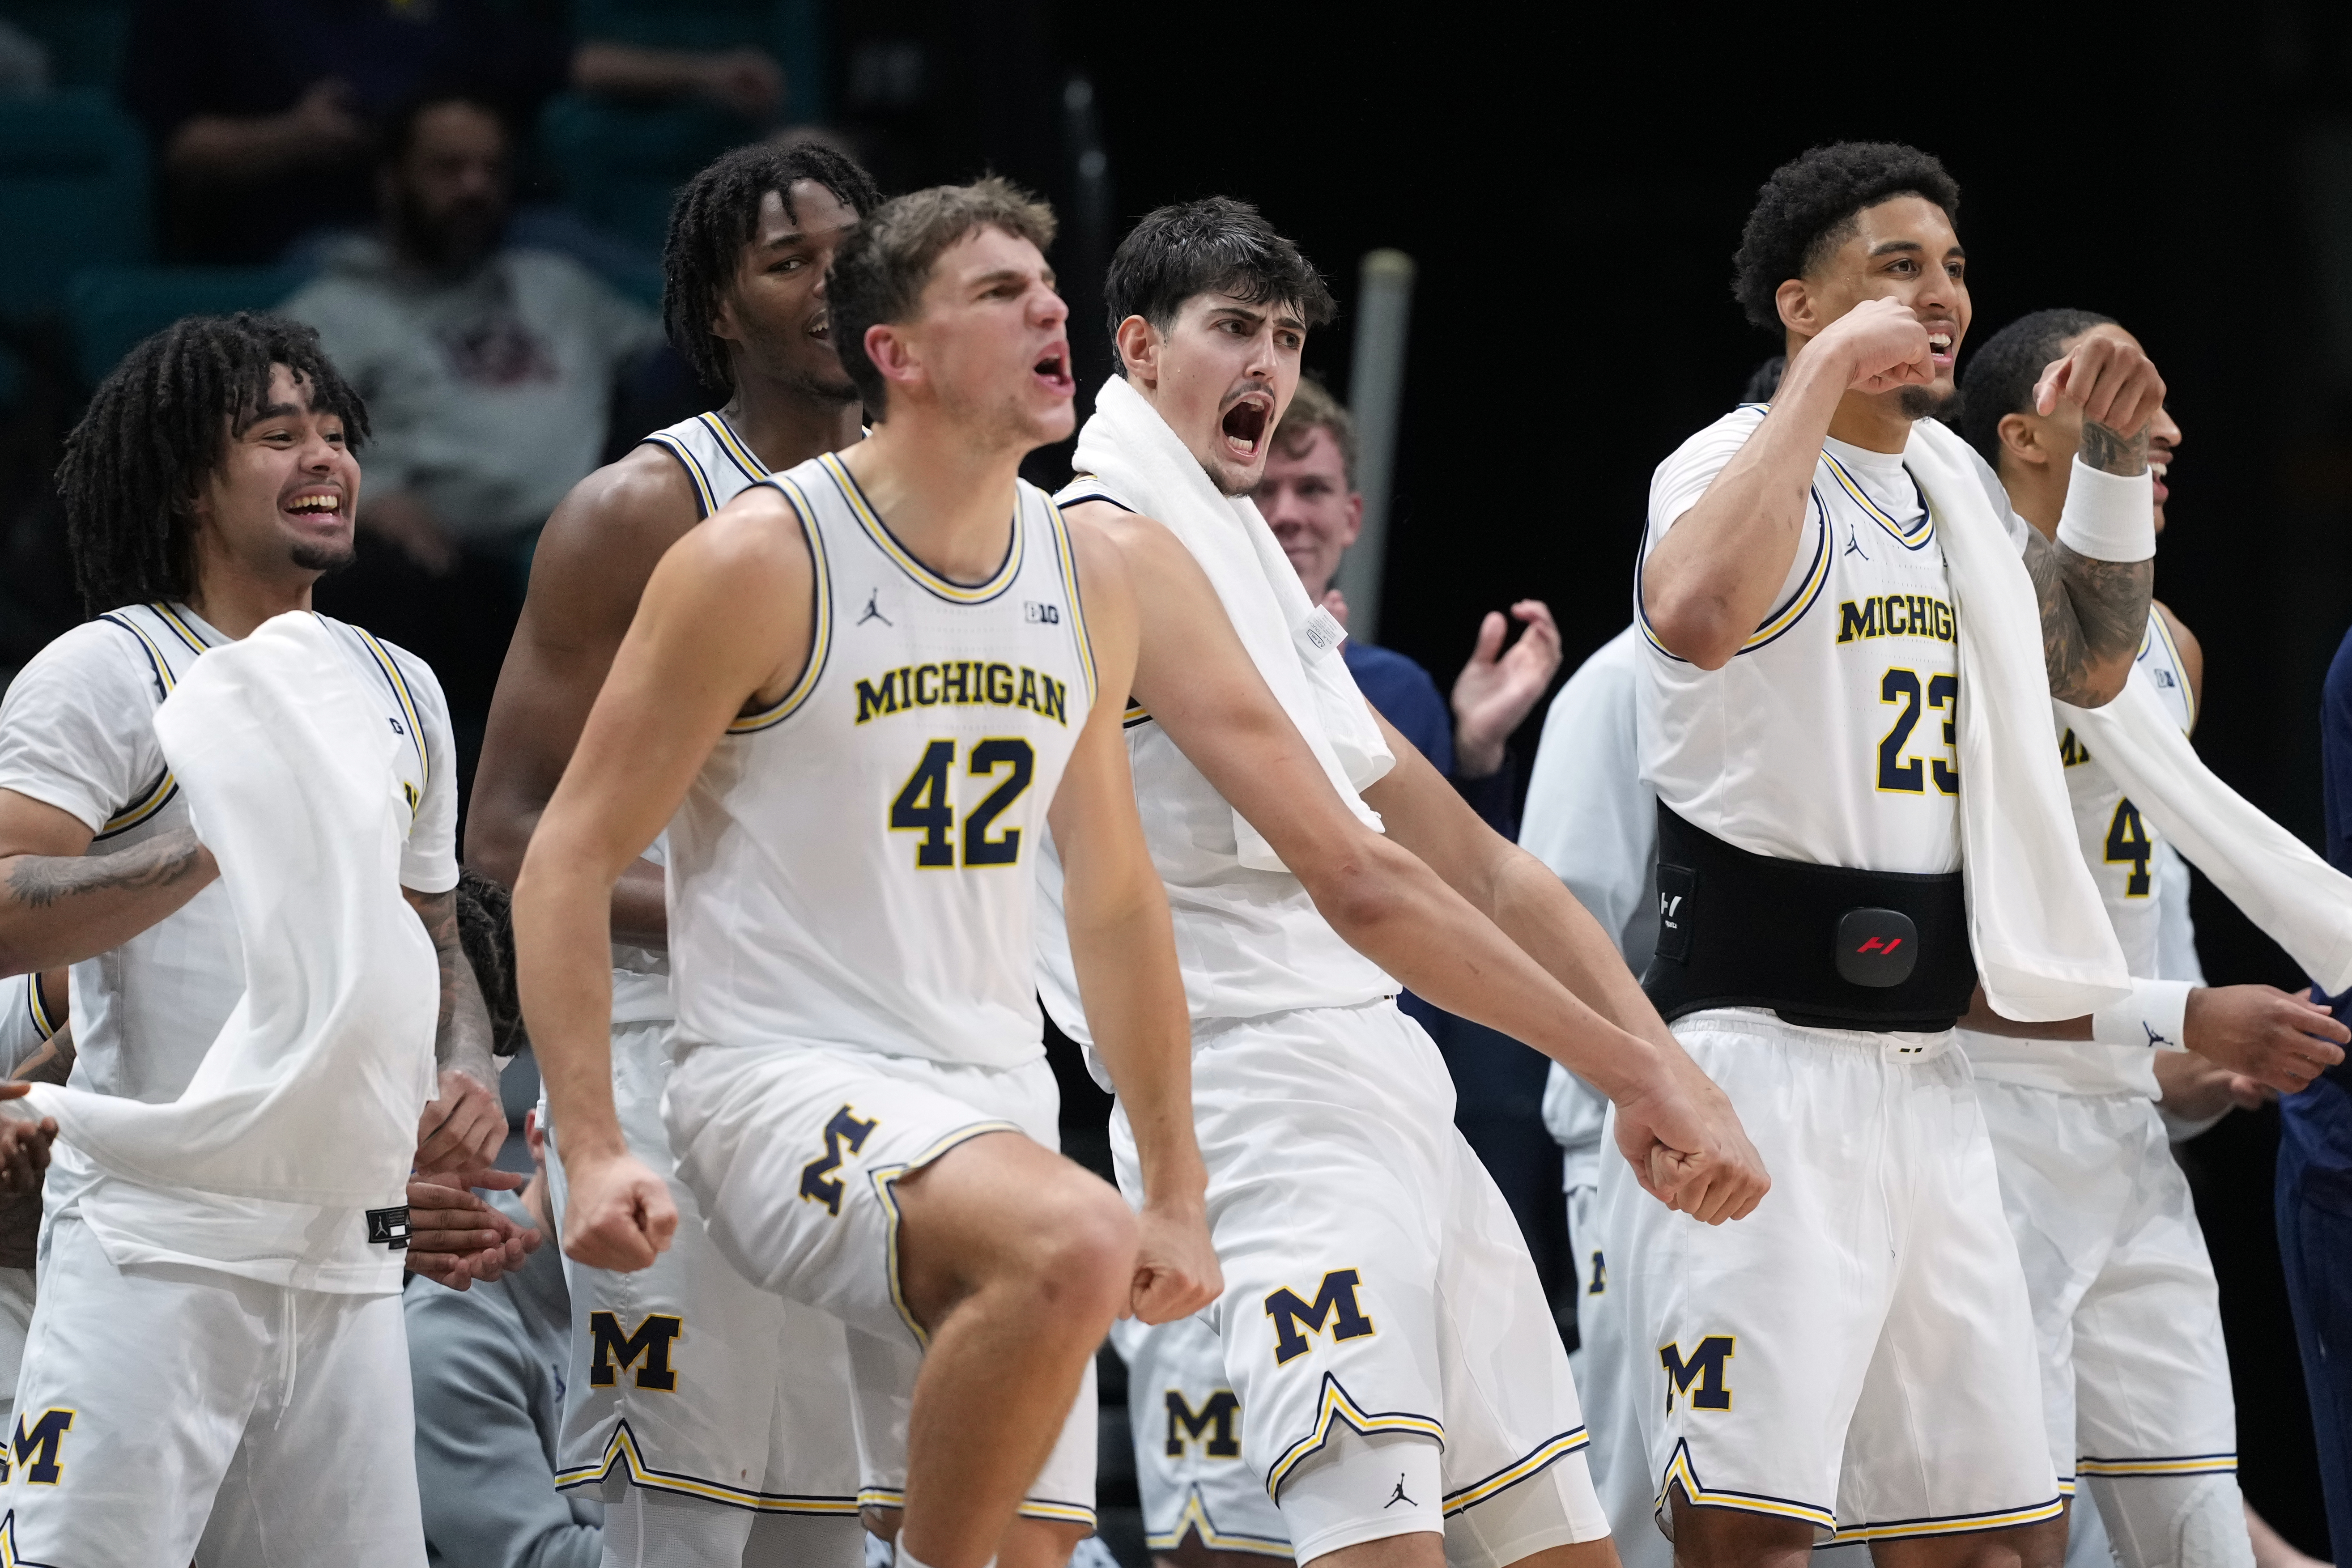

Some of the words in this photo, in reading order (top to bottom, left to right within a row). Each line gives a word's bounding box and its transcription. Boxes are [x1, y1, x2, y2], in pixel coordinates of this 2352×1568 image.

[1307, 620, 1322, 635] TOUCH
[1323, 635, 1333, 645] SILK
[1836, 594, 1957, 646] MICHIG
[855, 660, 1068, 729] MICHIGAN
[1876, 666, 1959, 796] 23
[888, 736, 1036, 870] 42
[2105, 795, 2152, 898] 4
[798, 1103, 880, 1216] M
[590, 1311, 683, 1393] M
[1263, 1267, 1376, 1368] M
[1659, 1334, 1736, 1422] M
[0, 1407, 77, 1485] M
[1165, 1390, 1242, 1459] M
